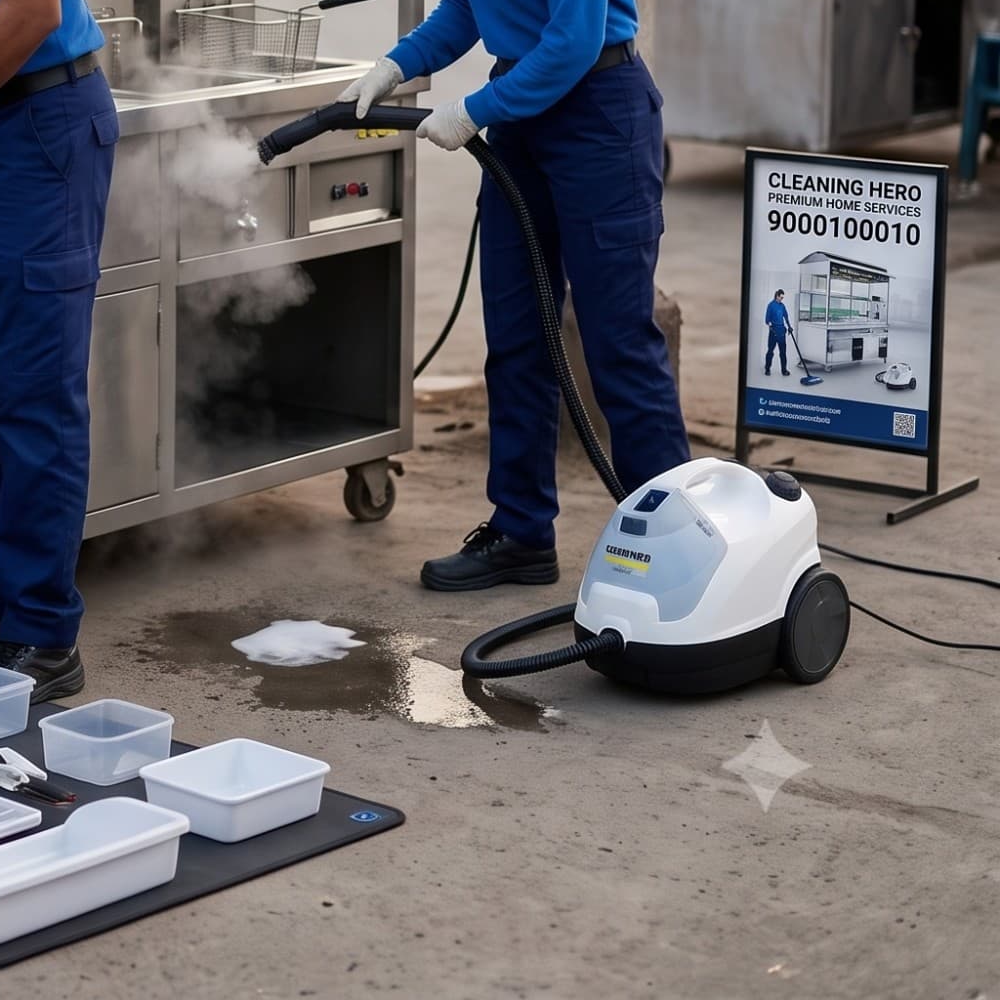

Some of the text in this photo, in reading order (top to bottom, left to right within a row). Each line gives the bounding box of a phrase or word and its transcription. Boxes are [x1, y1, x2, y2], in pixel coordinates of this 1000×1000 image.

[768, 172, 922, 202] CLEANING HERO
[768, 192, 921, 218] PREMIUM HOME SERVICES
[768, 210, 921, 246] 9000100010
